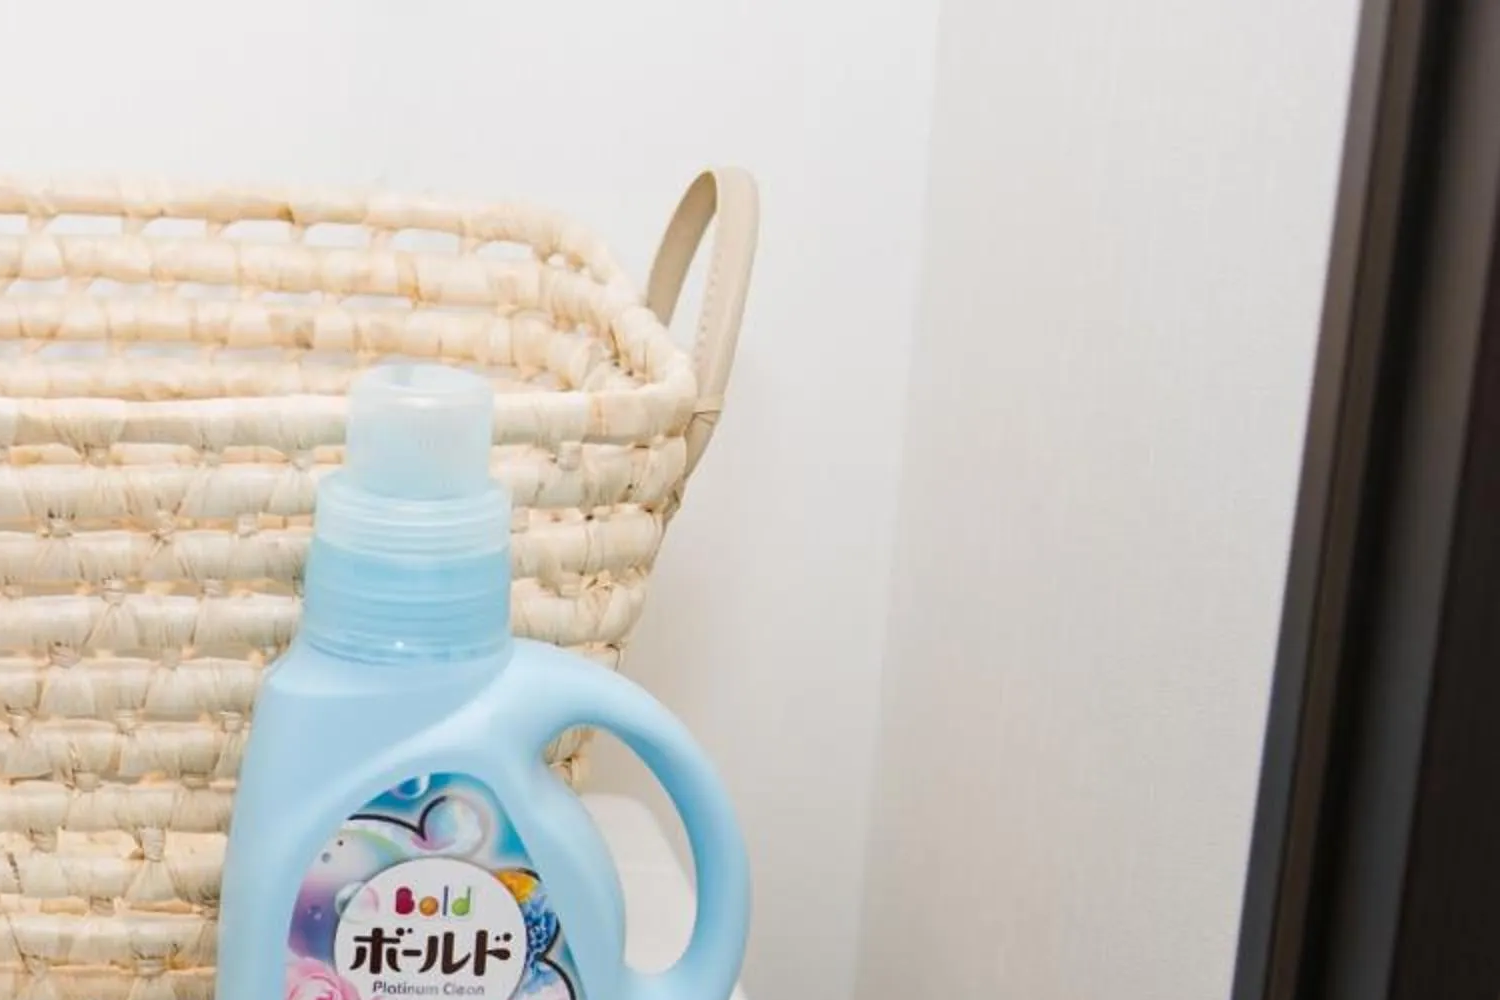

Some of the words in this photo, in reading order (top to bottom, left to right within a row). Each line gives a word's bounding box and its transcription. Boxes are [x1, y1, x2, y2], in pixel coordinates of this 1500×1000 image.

[395, 885, 471, 916] Bold
[349, 927, 513, 977] ボールド
[372, 980, 439, 996] Platinum
[443, 981, 485, 996] Clean
